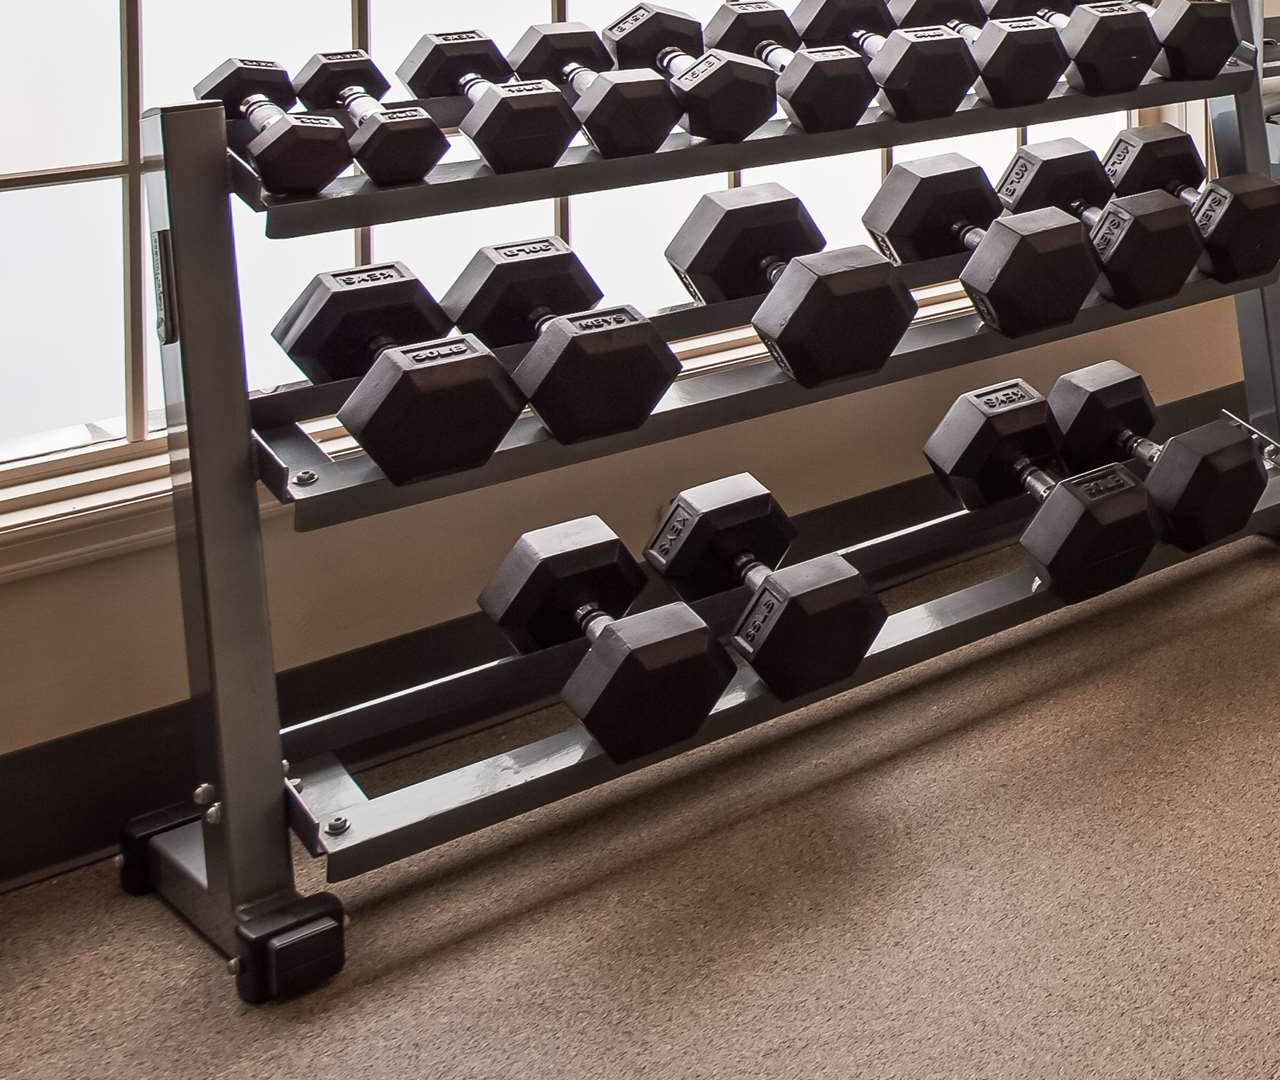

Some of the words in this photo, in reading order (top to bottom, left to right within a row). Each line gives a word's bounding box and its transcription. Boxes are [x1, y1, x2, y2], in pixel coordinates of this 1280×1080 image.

[1105, 145, 1131, 177] 40LB
[1003, 161, 1029, 197] 40LB
[502, 243, 552, 258] 30LB
[342, 271, 394, 286] KEYS
[577, 313, 627, 331] KEYS
[411, 344, 468, 362] 30LB
[983, 389, 1027, 409] KEYS
[658, 517, 689, 556] KEYS
